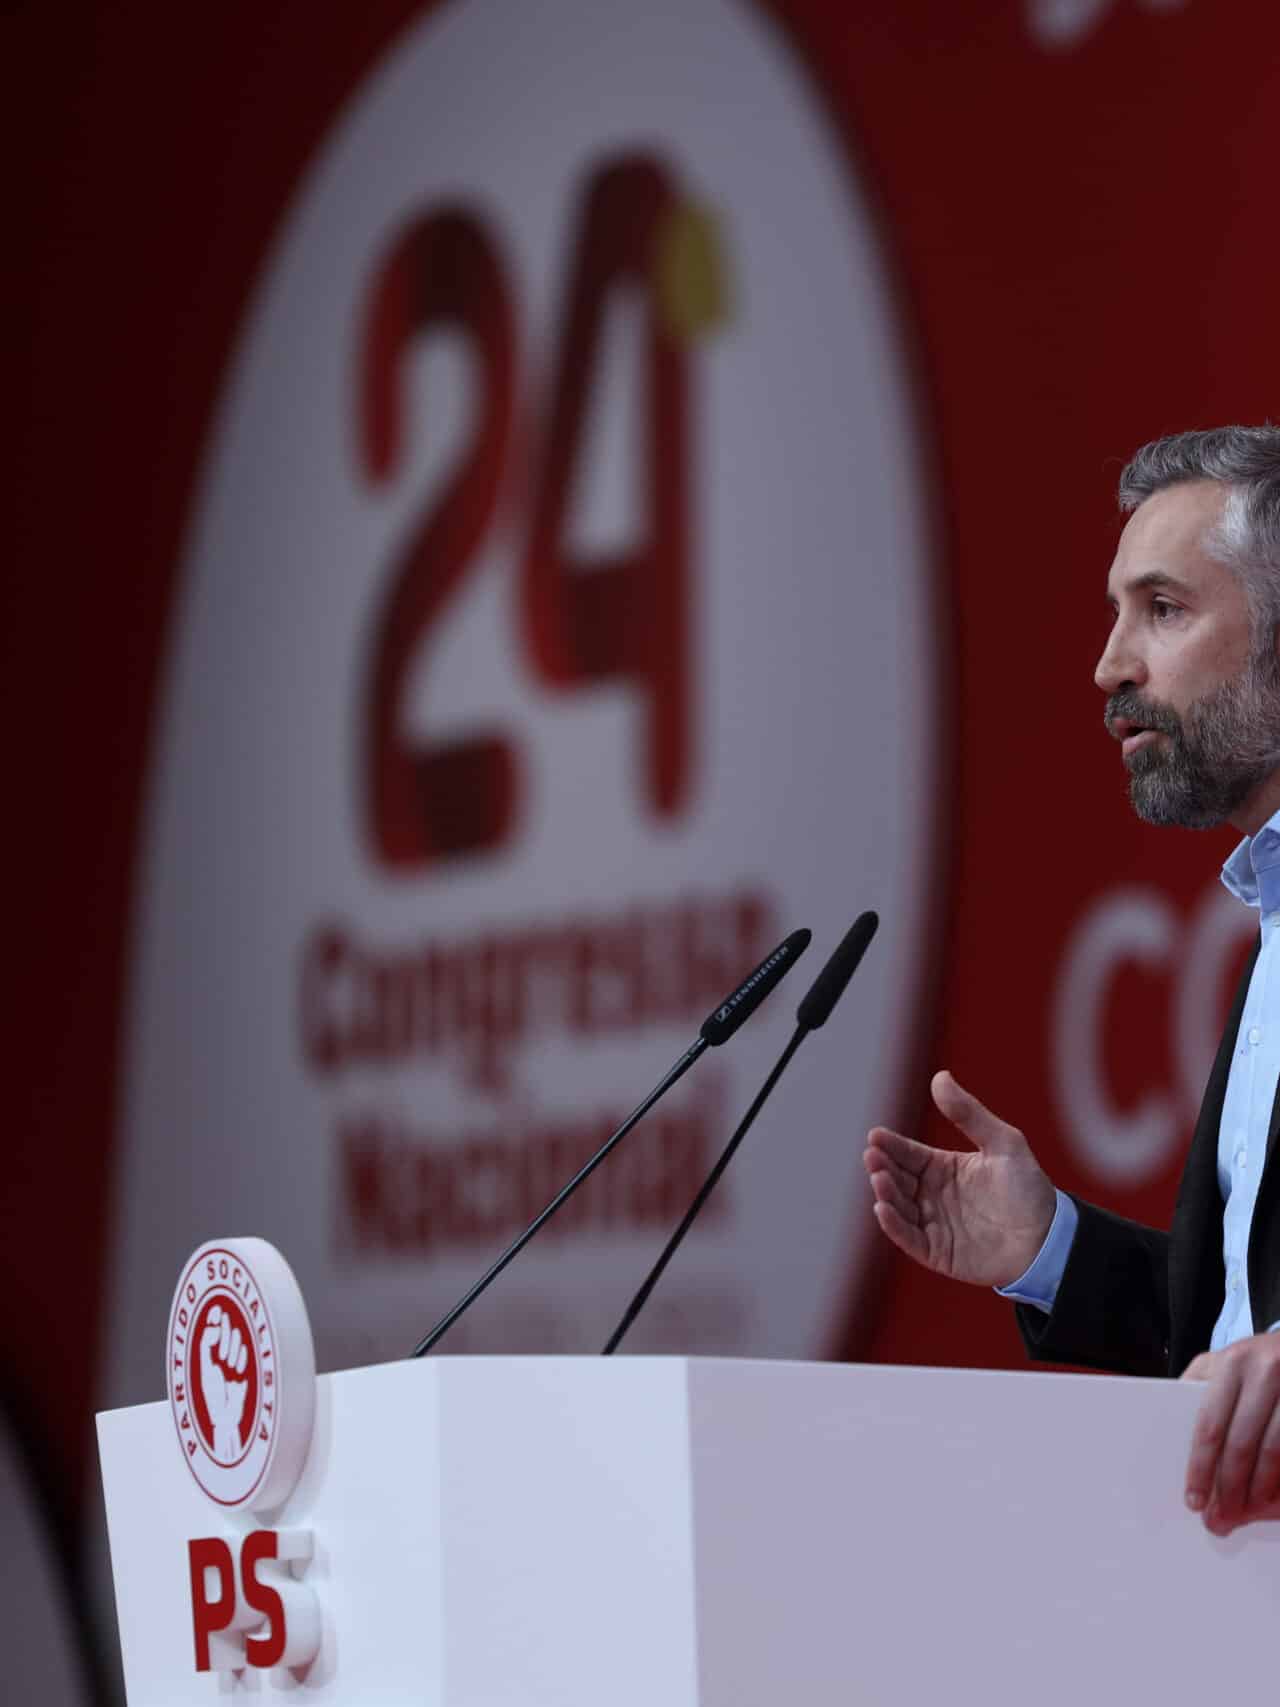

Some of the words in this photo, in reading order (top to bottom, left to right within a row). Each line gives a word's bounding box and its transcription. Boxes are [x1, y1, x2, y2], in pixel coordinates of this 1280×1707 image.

[175, 1282, 199, 1457] PARTIDO
[206, 1258, 274, 1443] SOCIALISTA
[188, 1529, 287, 1673] PS
